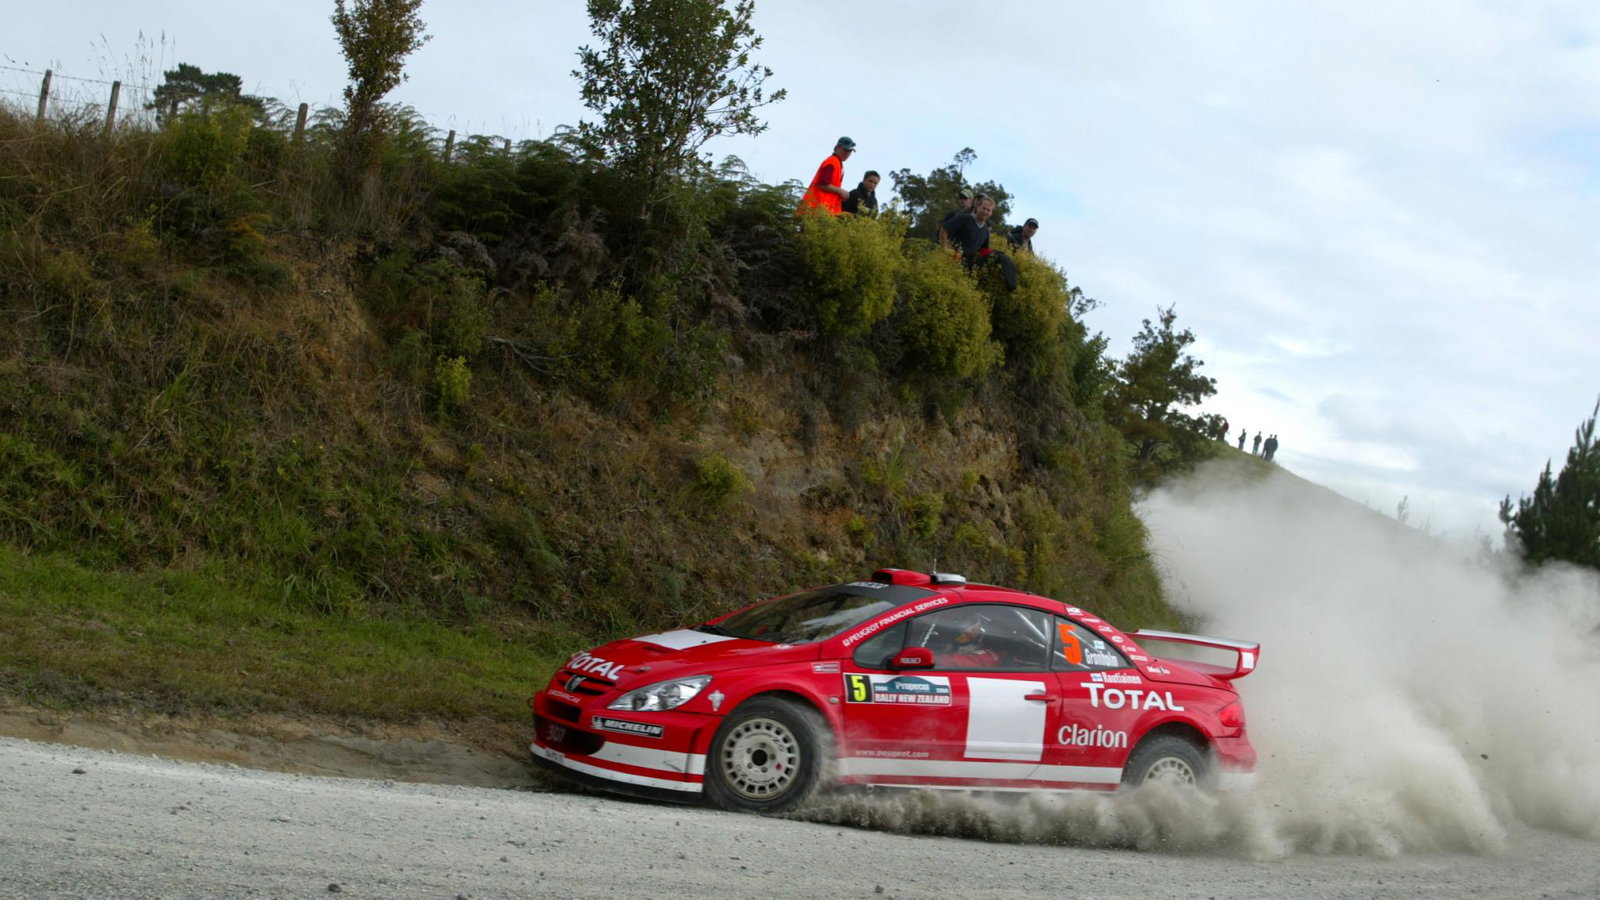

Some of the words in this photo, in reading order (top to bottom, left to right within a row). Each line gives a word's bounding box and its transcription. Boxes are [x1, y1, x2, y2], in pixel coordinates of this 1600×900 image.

[849, 622, 880, 643] PEUGEOT
[879, 607, 916, 627] FINANCIAL
[914, 597, 949, 612] SERVICES
[1057, 623, 1082, 665] 5
[566, 651, 625, 680] TOTAL
[851, 675, 867, 702] 5
[894, 681, 930, 692] Propecia
[1101, 671, 1142, 685] Rautiainen
[874, 693, 898, 703] RALLY
[898, 694, 917, 703] NEW
[917, 694, 950, 704] ZEALAND
[1080, 682, 1185, 711] TOTAL
[604, 719, 663, 735] MICHELIN
[1058, 724, 1128, 748] Clarion
[854, 750, 929, 759] www.peugeot.com
